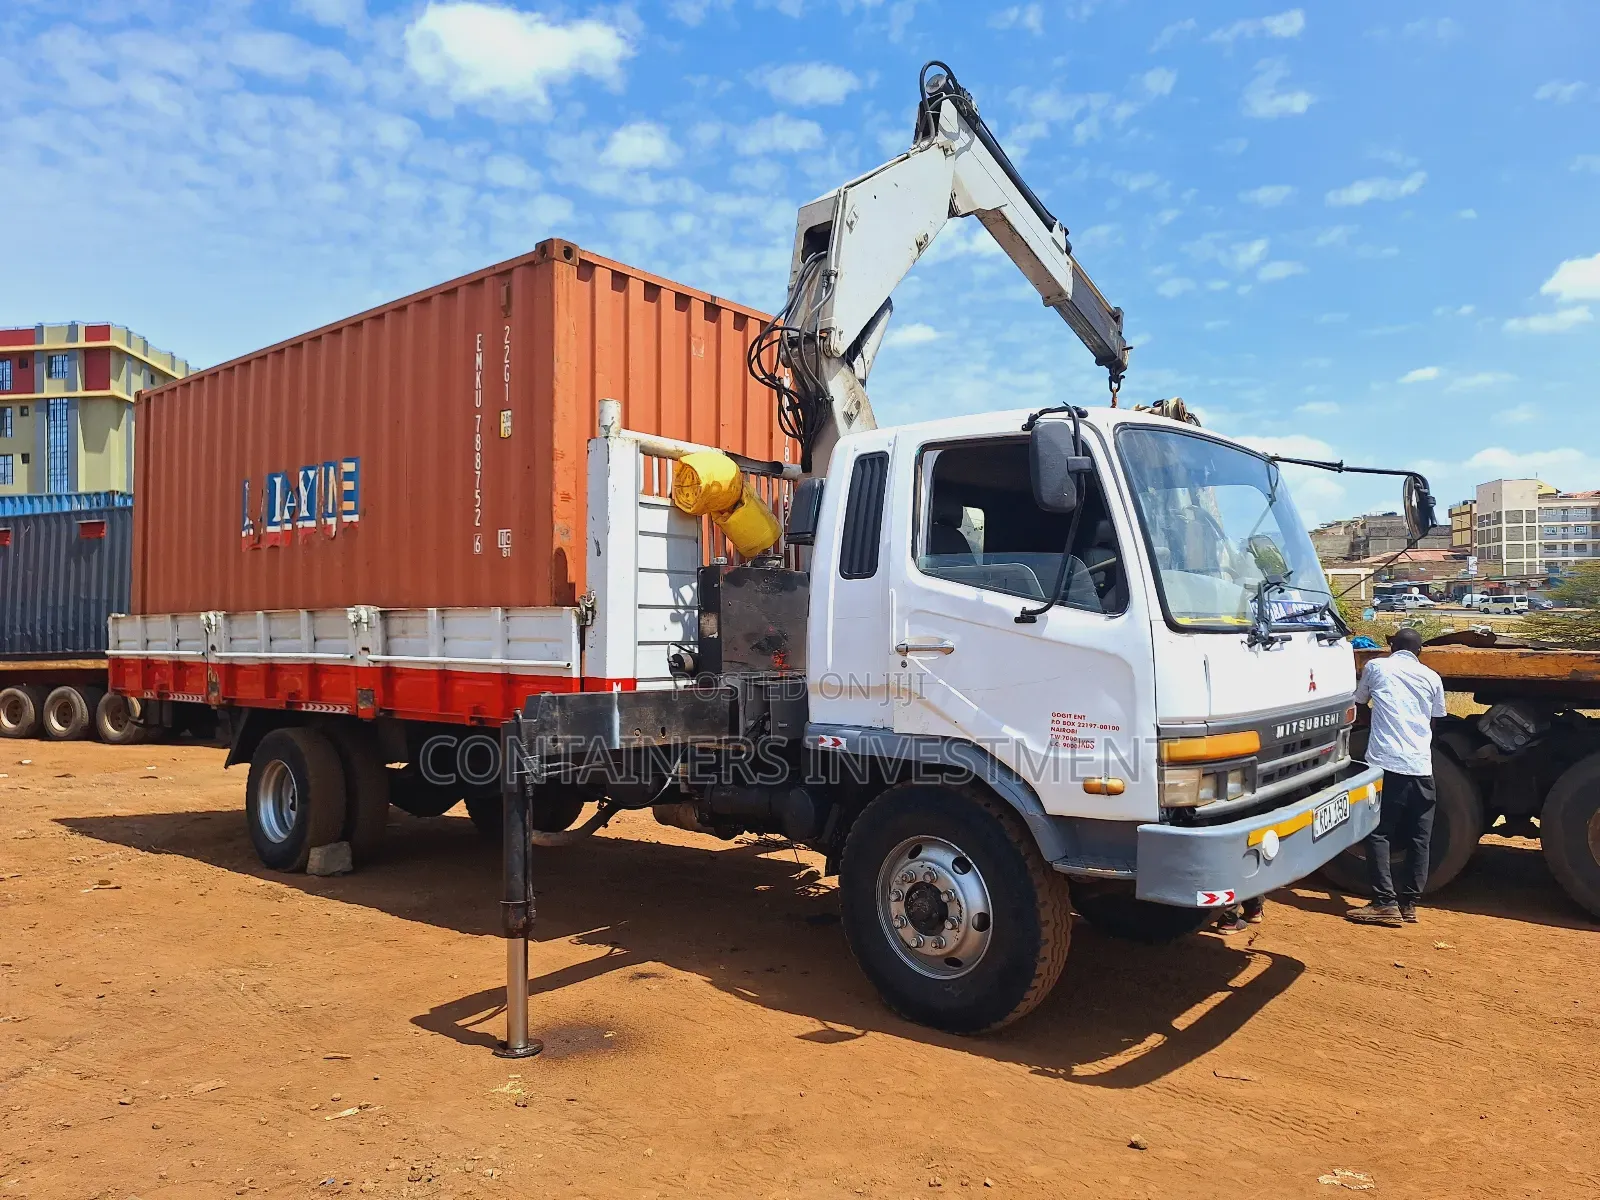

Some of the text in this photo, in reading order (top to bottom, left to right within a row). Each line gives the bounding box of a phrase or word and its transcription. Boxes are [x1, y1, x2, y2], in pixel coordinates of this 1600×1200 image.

[475, 333, 483, 408] EMKU
[503, 325, 511, 402] 22G1
[474, 414, 482, 527] 788752
[1275, 712, 1340, 739] MITSUBISHI
